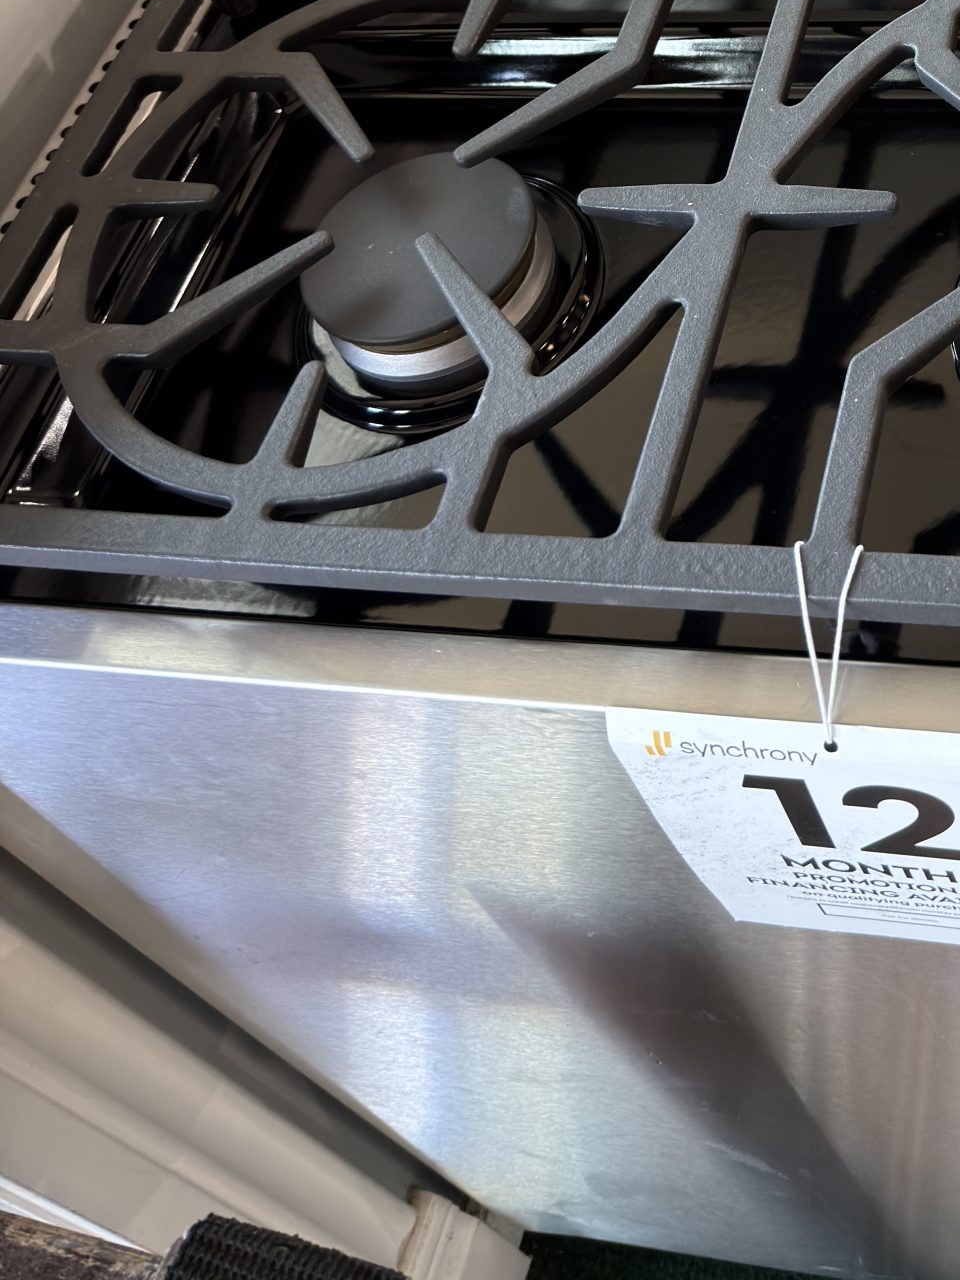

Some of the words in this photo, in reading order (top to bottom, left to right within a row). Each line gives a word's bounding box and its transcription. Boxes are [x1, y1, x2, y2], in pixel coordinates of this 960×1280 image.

[680, 740, 817, 766] synchrony
[746, 876, 900, 898] FINANCING
[827, 893, 910, 907] qualifying
